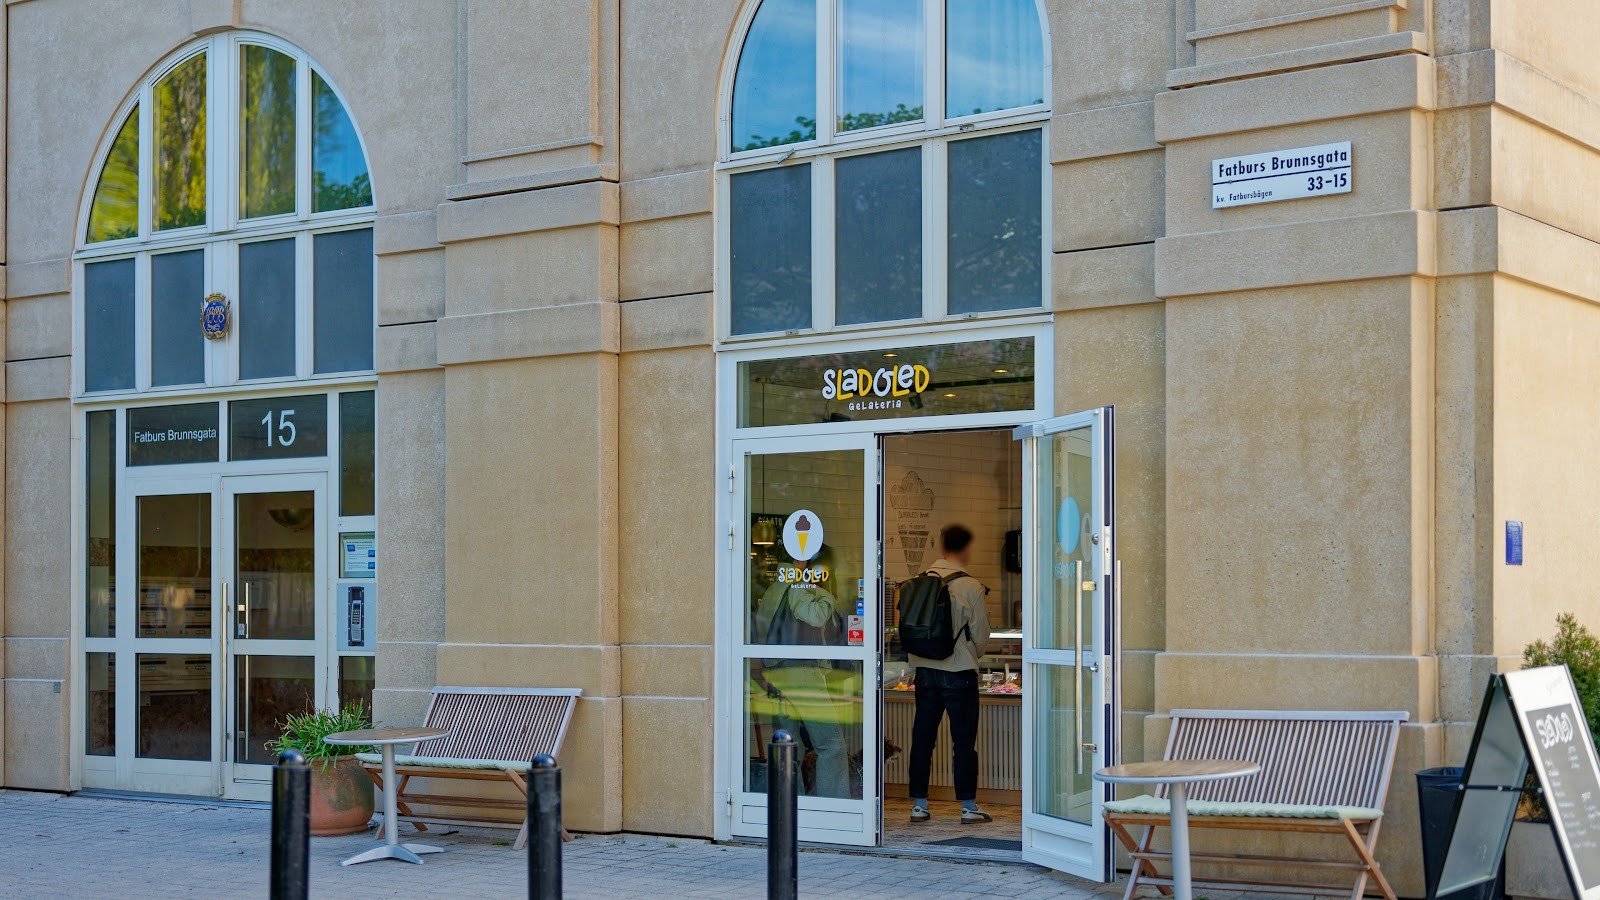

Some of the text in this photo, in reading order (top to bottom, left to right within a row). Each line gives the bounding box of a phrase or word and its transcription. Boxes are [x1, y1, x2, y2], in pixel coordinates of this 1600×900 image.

[1219, 150, 1347, 177] Fatburs Brunnsgata
[1308, 173, 1347, 191] 33-15
[1229, 190, 1273, 202] Fatbursbågen
[134, 427, 216, 443] Fatburs Brunnsgata
[261, 410, 297, 447] 15
